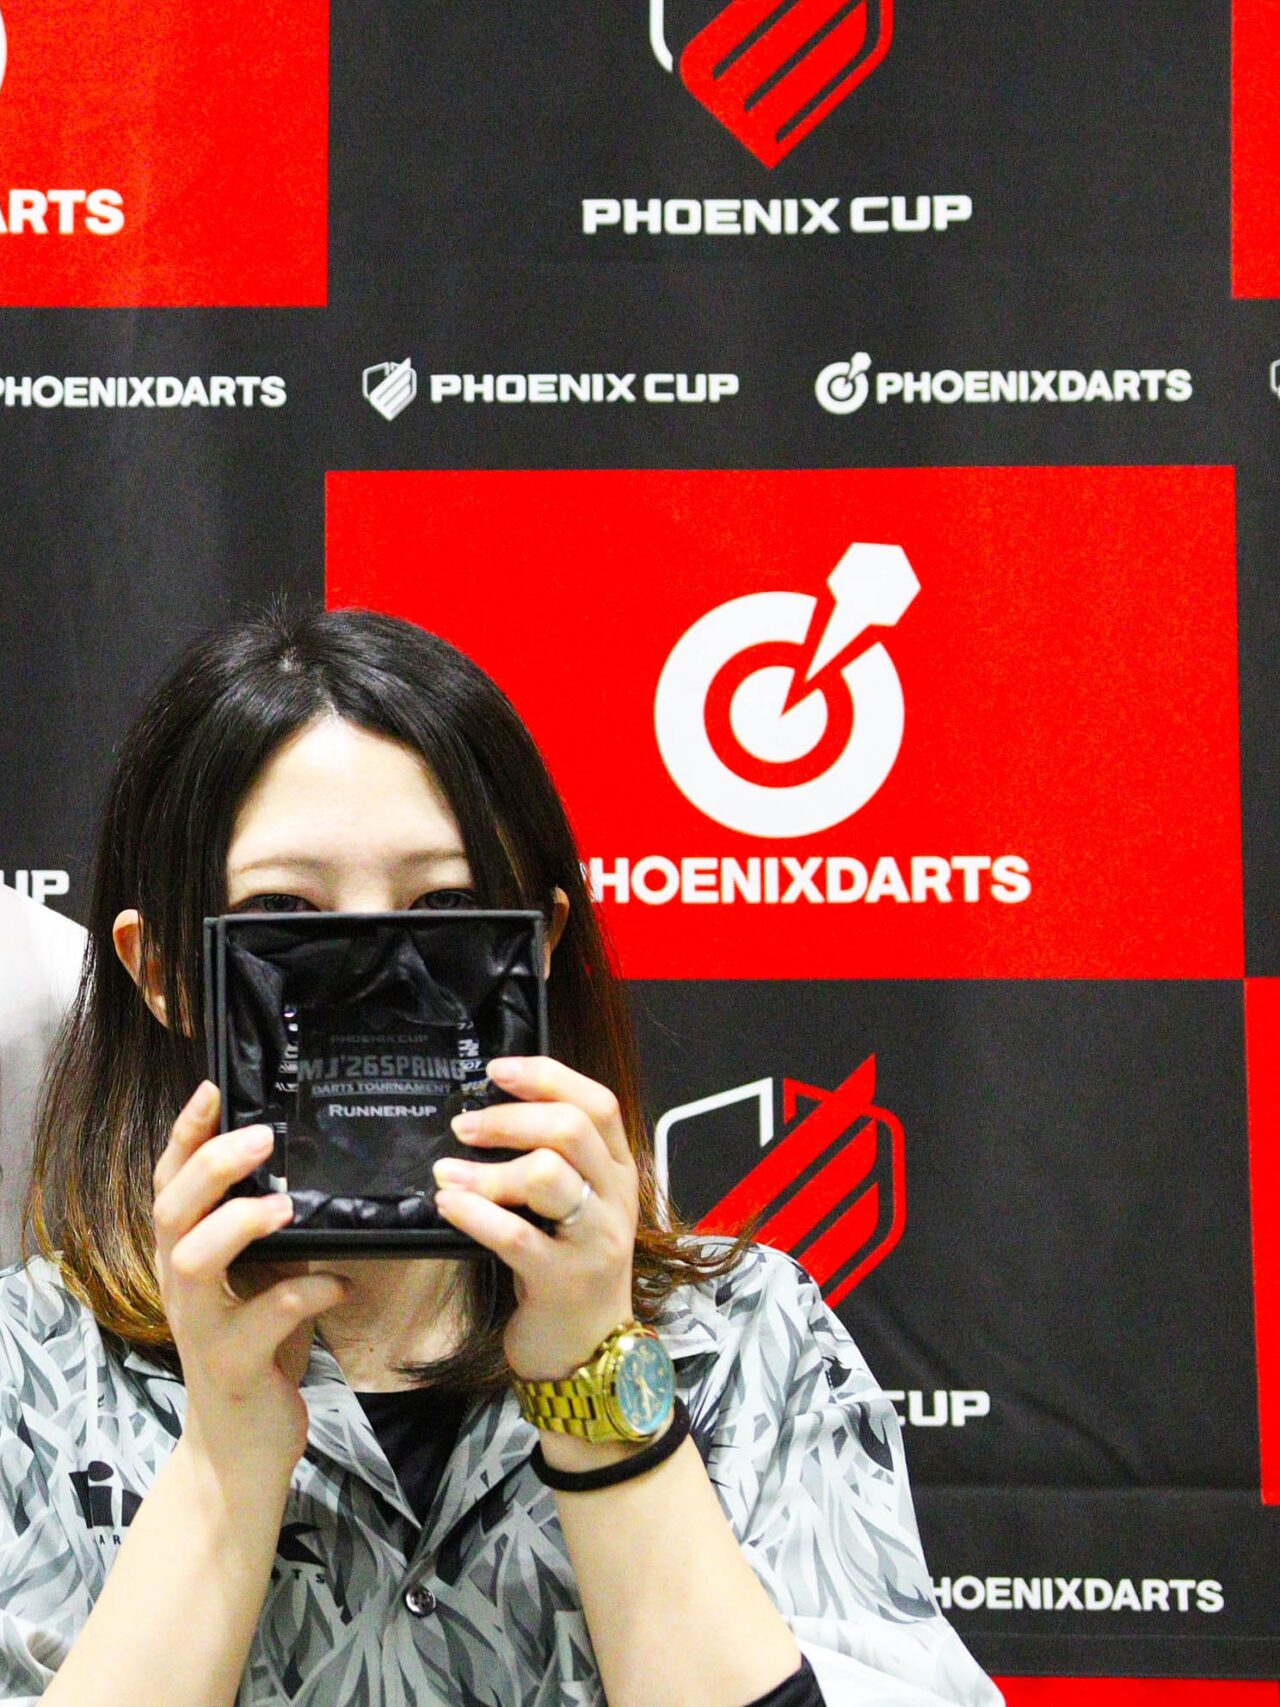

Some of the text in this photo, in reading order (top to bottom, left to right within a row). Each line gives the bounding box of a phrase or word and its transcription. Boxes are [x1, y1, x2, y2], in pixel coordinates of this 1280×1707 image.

[582, 194, 973, 235] PHOENIX CUP
[430, 373, 739, 403] PHOENIX CUP
[876, 368, 1193, 404] PHOENIXDARTS
[580, 855, 1031, 905] HOENIXDARTS
[311, 1081, 452, 1097] DARTS TOURNAMENT
[328, 1103, 438, 1118] RUNNER-UP
[929, 1575, 1225, 1613] HOENIXDARTS
